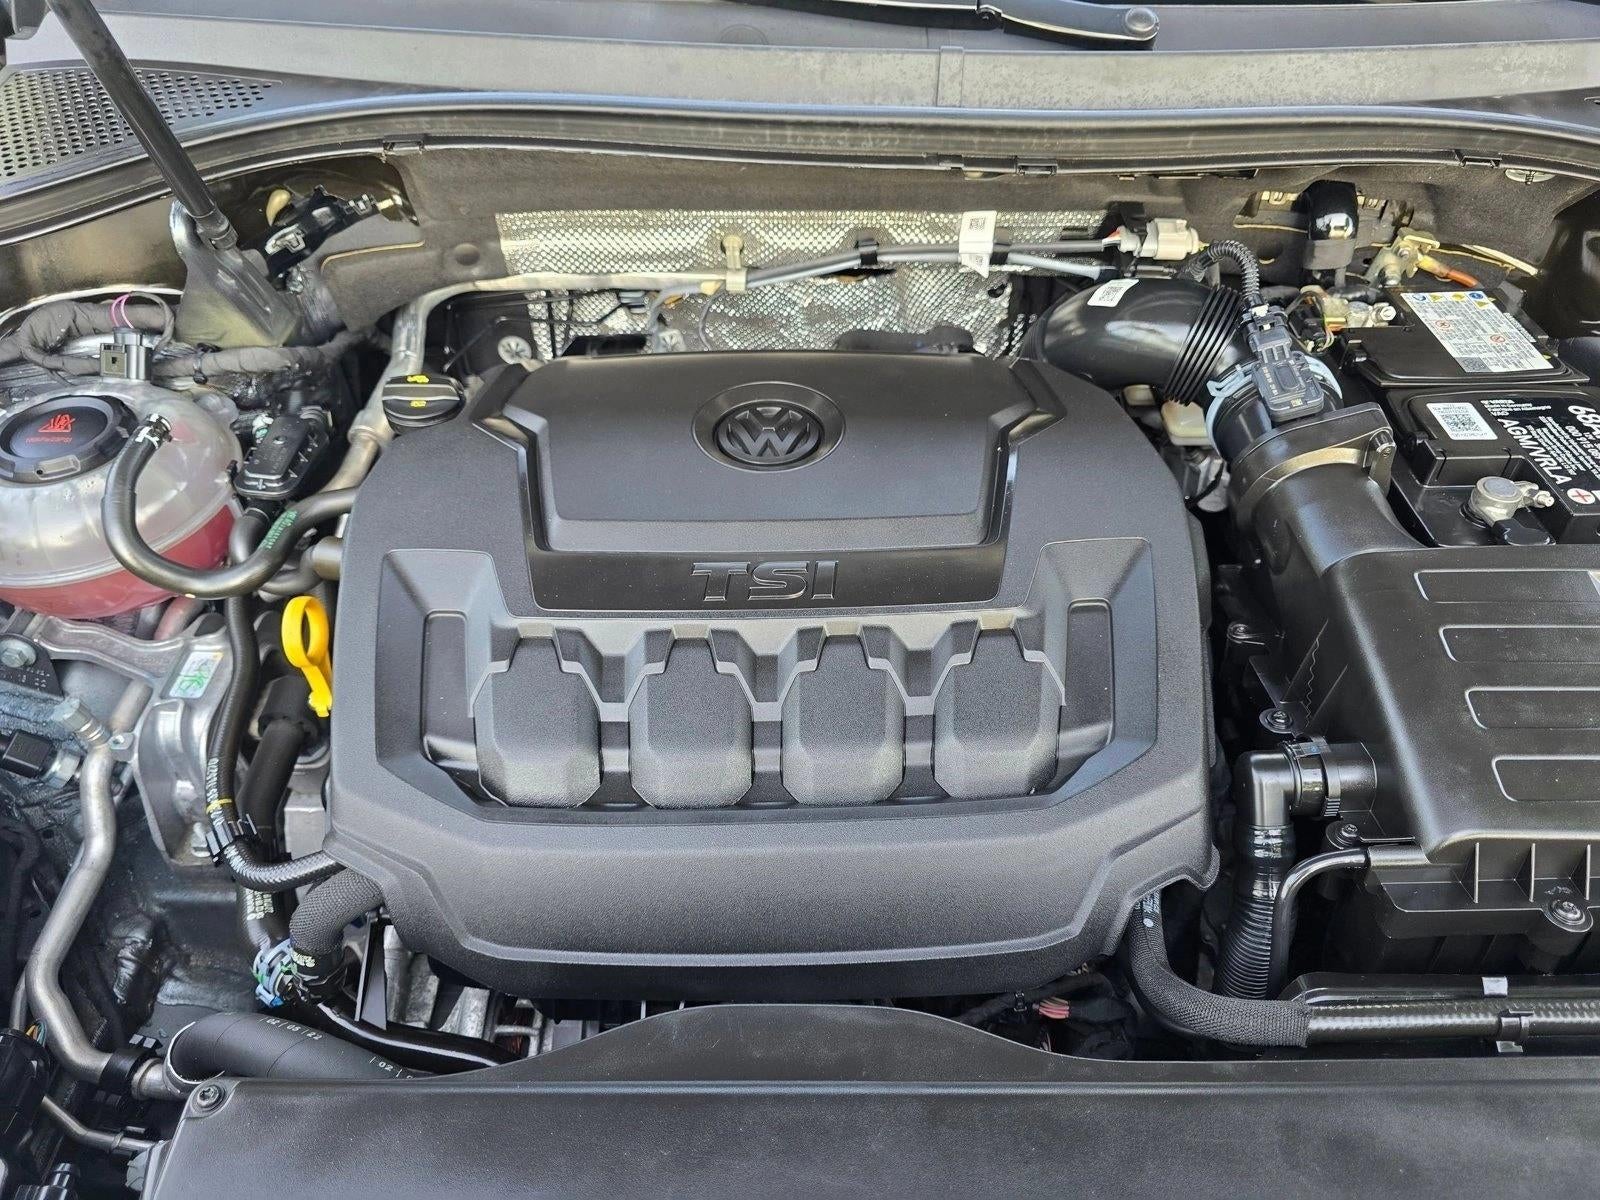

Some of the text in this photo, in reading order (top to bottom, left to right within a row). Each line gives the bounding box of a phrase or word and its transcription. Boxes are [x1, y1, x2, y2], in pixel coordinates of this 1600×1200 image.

[714, 399, 822, 467] VW
[691, 560, 839, 602] TSI
[378, 1061, 394, 1072] 02
